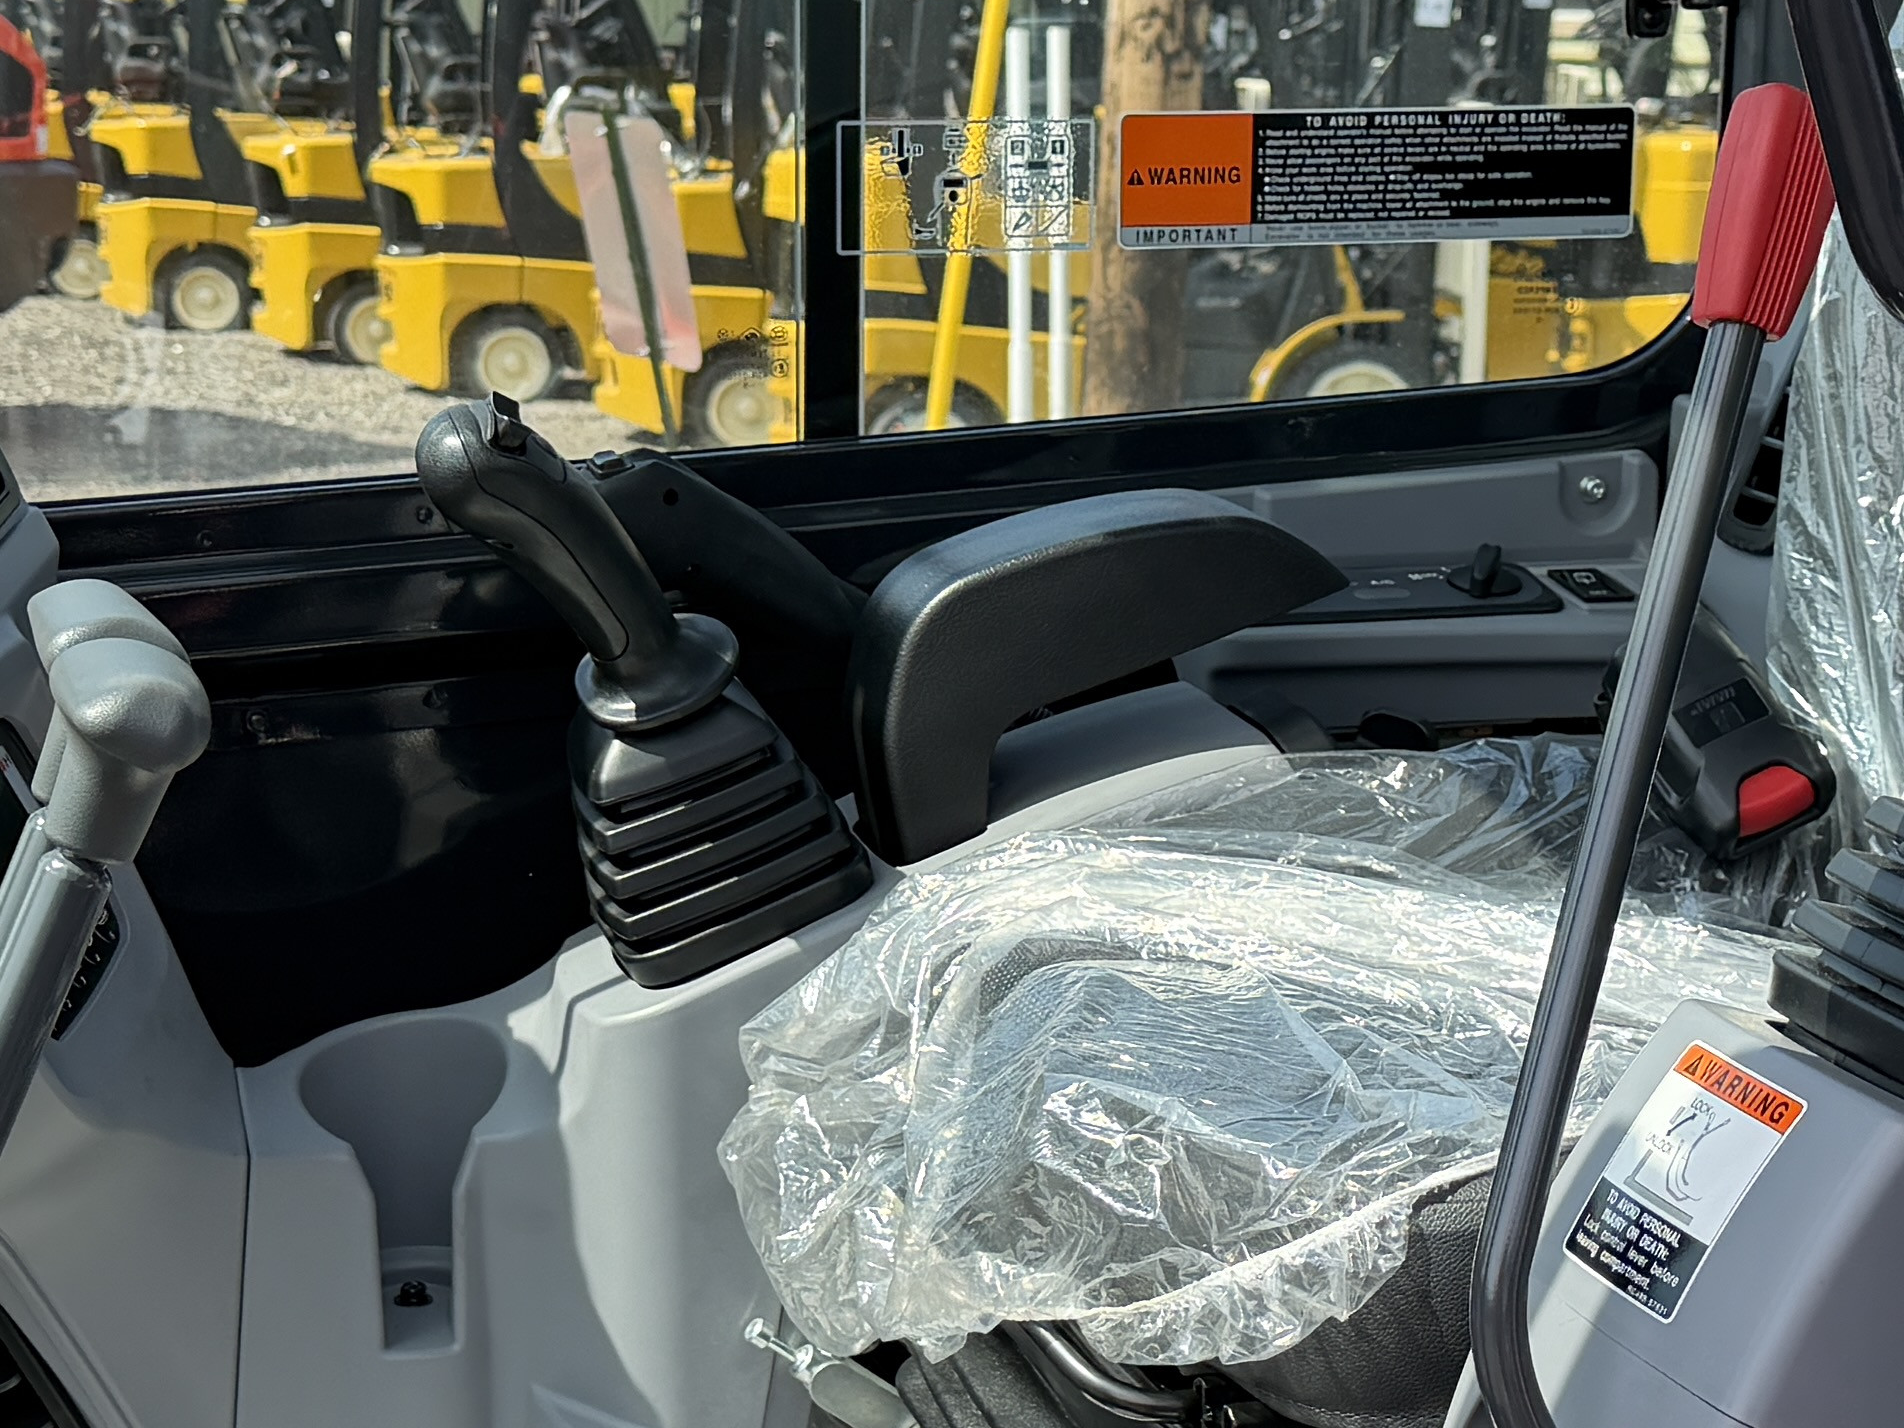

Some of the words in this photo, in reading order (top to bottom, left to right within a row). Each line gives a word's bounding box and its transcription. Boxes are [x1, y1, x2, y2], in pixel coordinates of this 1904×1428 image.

[1306, 115, 1322, 127] TO
[1328, 114, 1368, 127] AVOID
[1374, 114, 1441, 126] PERSONAL
[1448, 113, 1494, 125] INJURY
[1498, 112, 1517, 124] OR
[1147, 165, 1242, 186] WARNING
[1136, 227, 1238, 244] IMPORTANT
[1700, 1059, 1790, 1125] WARNING
[1606, 1188, 1619, 1204] TO
[1616, 1197, 1641, 1221] AVOID
[1639, 1212, 1681, 1249] PERSONAL
[1626, 1225, 1641, 1243] OR
